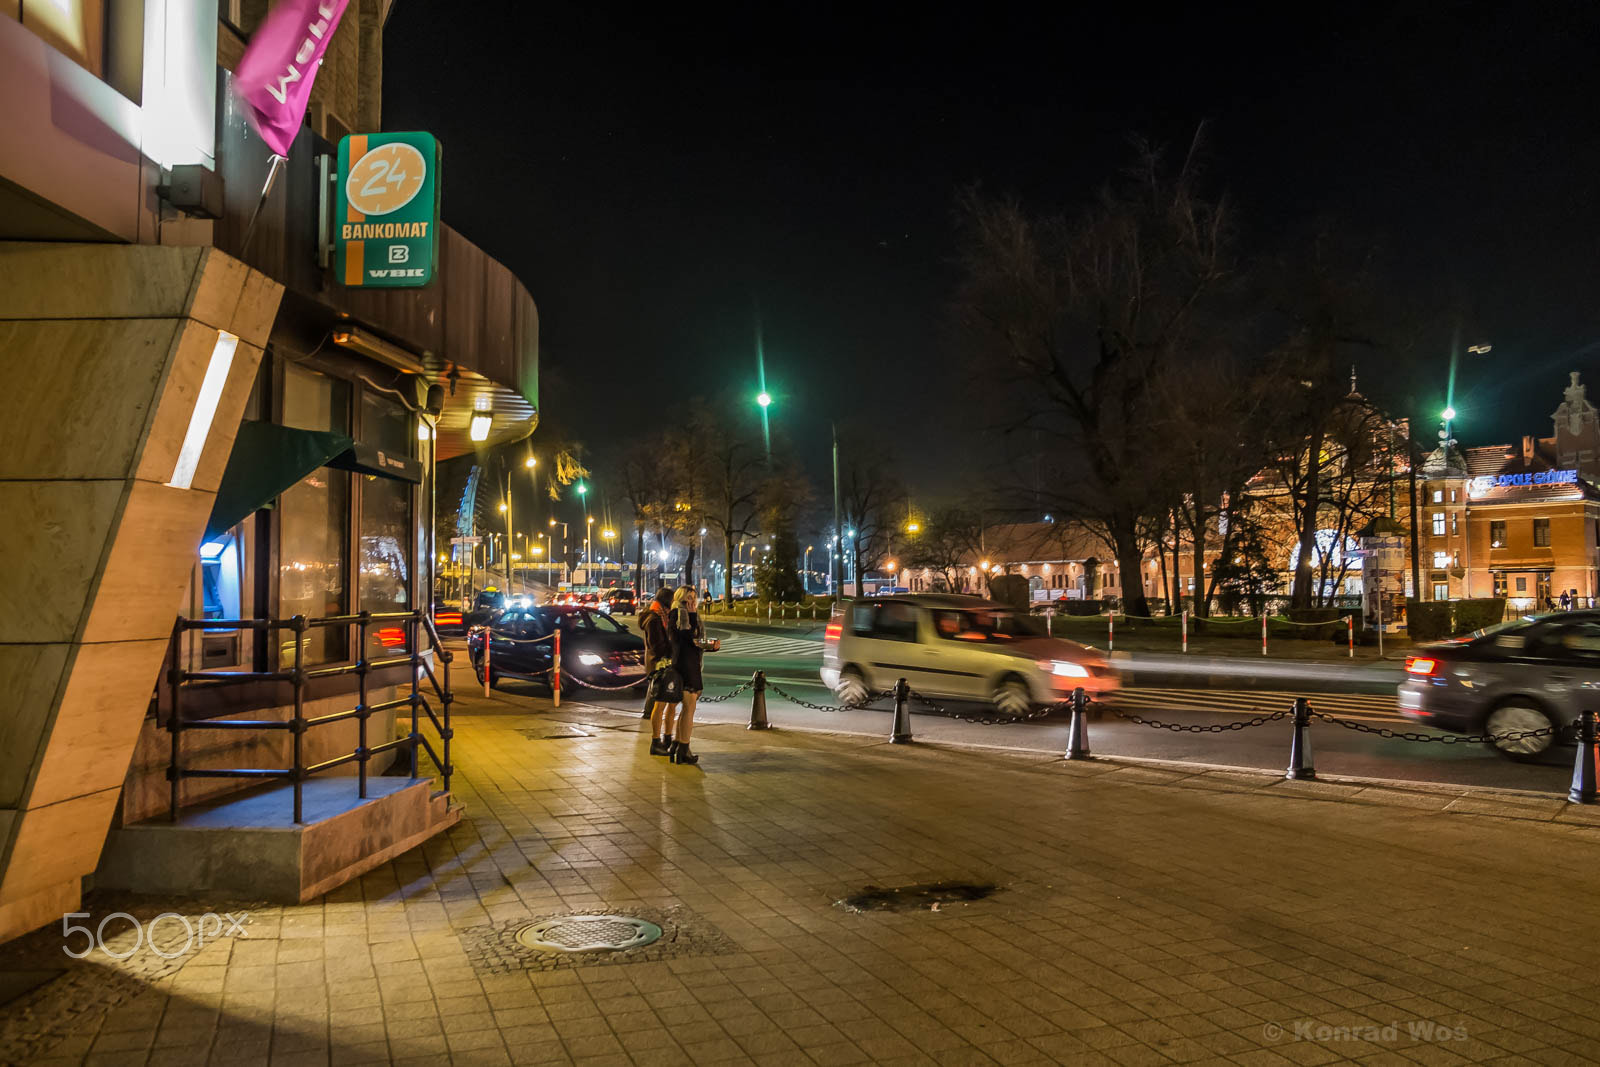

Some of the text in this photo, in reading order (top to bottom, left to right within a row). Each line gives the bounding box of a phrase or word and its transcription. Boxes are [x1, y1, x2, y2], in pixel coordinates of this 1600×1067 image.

[359, 157, 407, 197] 24
[342, 221, 429, 239] BANKOMAT
[368, 268, 425, 278] WBK
[1497, 473, 1533, 487] OPOLE
